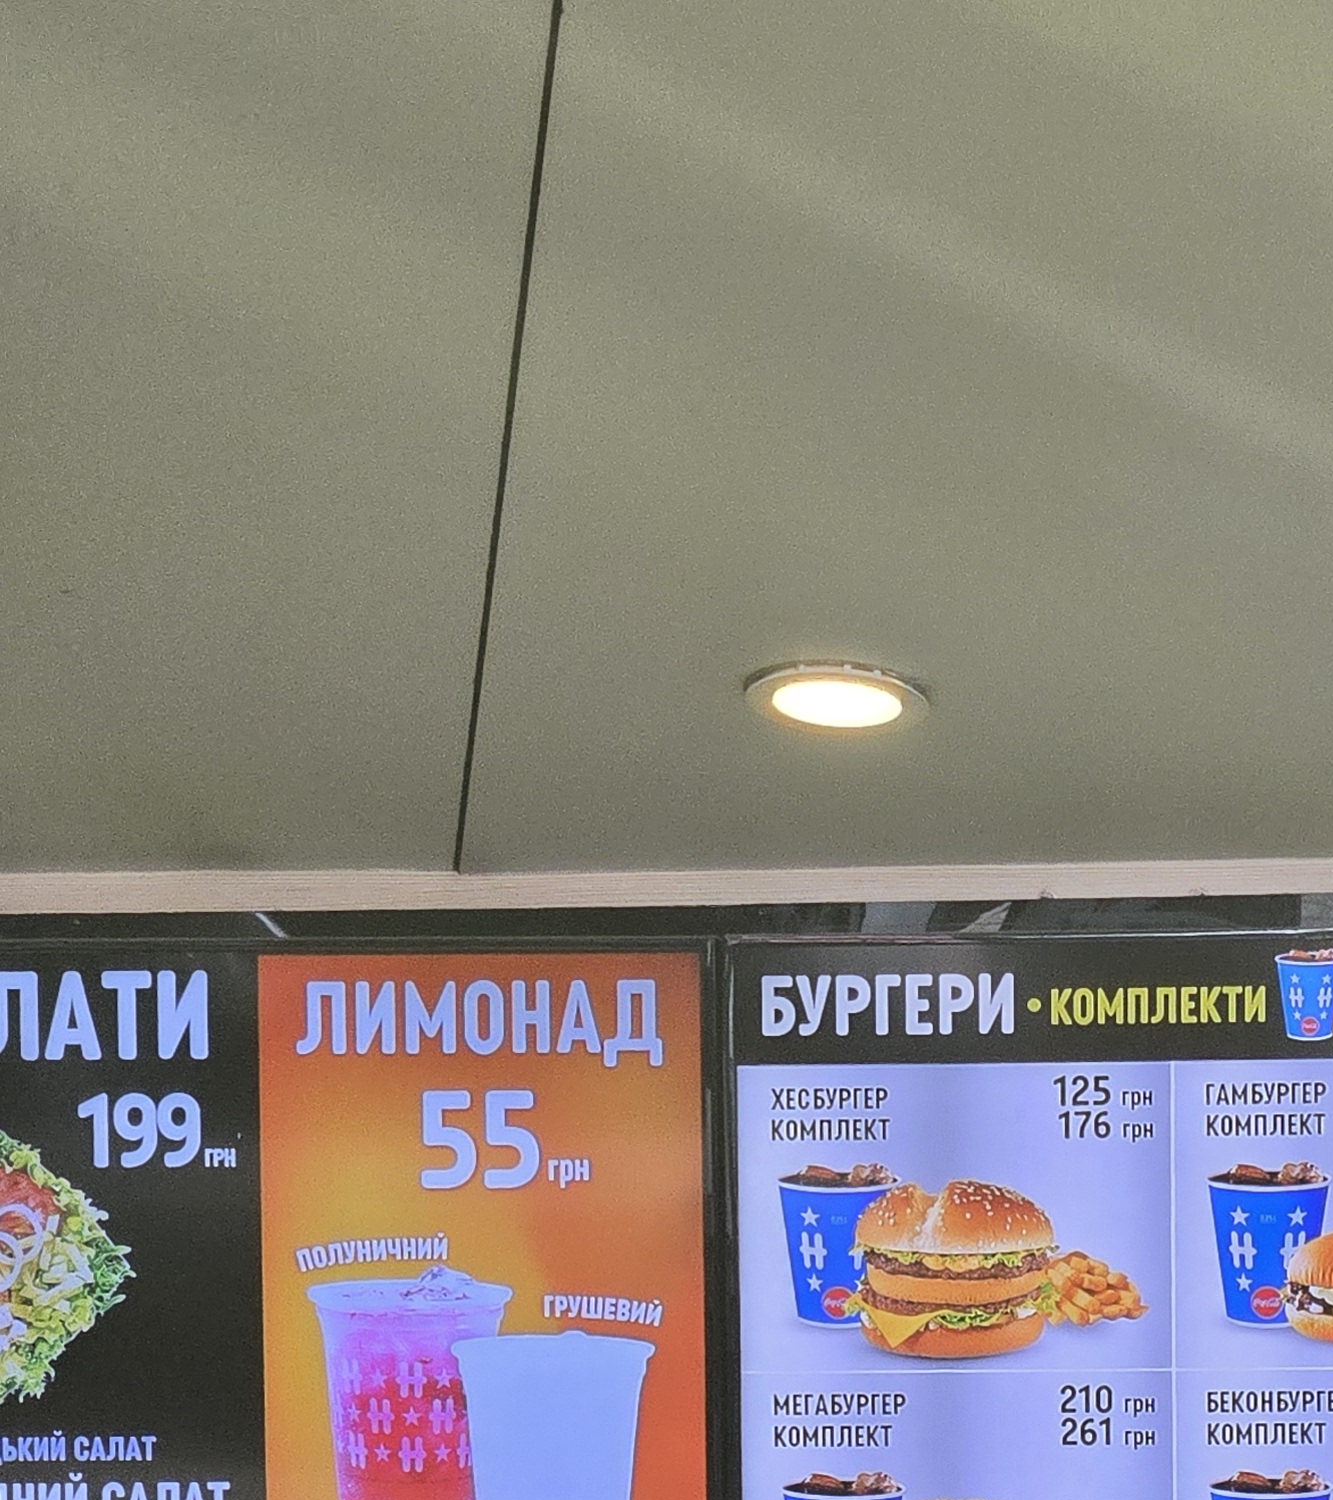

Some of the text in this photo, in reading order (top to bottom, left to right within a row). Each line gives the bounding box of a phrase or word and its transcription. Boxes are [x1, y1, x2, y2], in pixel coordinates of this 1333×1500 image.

[0, 970, 209, 1061] ЛАТИ
[762, 973, 1266, 1037] БУРГЕРИ КОМПЛЕКТИ
[296, 980, 663, 1067] ЛИМОНАД
[771, 1088, 888, 1109] ХЕСБУРГЕР
[1053, 1076, 1154, 1109] 125 грн
[1206, 1083, 1327, 1105] ГАМБУРГЕР
[77, 1093, 236, 1169] 199 ГРН
[421, 1090, 590, 1189] 55 грн
[771, 1119, 891, 1141] КОМПЛЕКТ
[1058, 1111, 1154, 1142] 176 грн
[1206, 1113, 1325, 1136] КОМПЛЕКТ
[296, 1234, 448, 1272] ПОЛУНИЧНИЙ
[543, 1295, 663, 1326] ГРУШЕВИЙ
[773, 1393, 906, 1416] МЕГАБУРГЕР
[1060, 1386, 1156, 1417] 210 грн
[0, 1430, 157, 1465] ЬКИЙ САЛАТ
